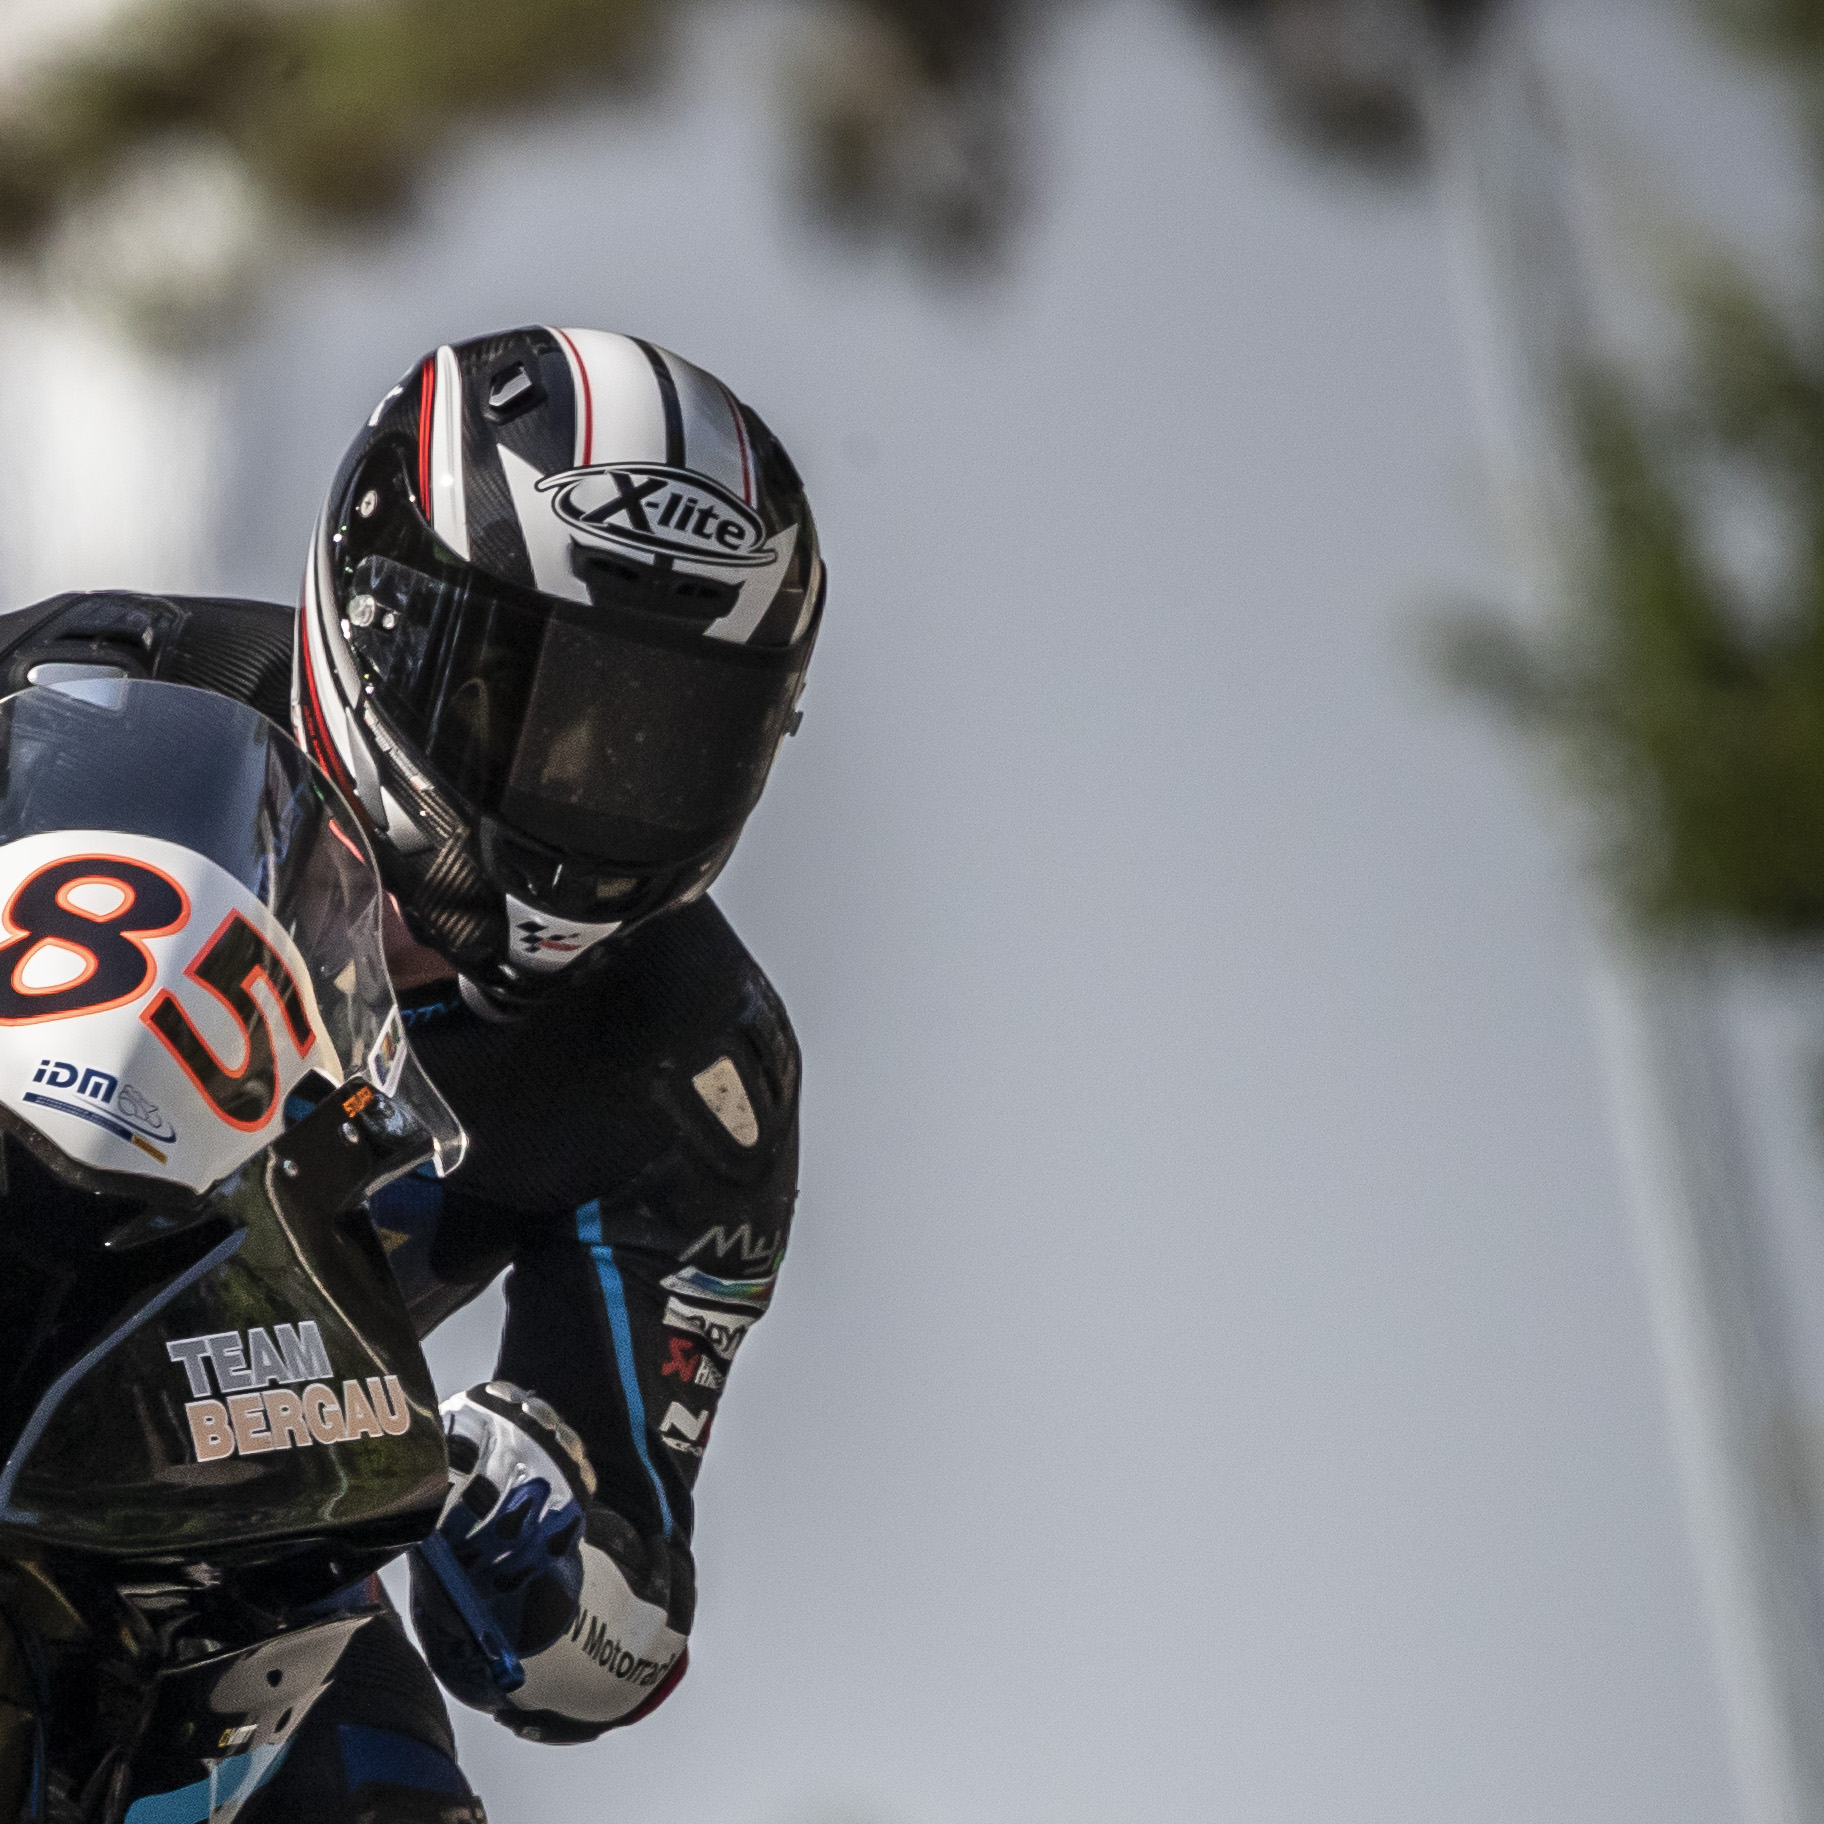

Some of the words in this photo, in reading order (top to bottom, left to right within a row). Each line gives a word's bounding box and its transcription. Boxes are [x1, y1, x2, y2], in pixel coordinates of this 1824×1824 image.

[582, 470, 746, 551] X-lite
[165, 1320, 335, 1398] TEAM
[184, 1374, 412, 1463] BERGAU
